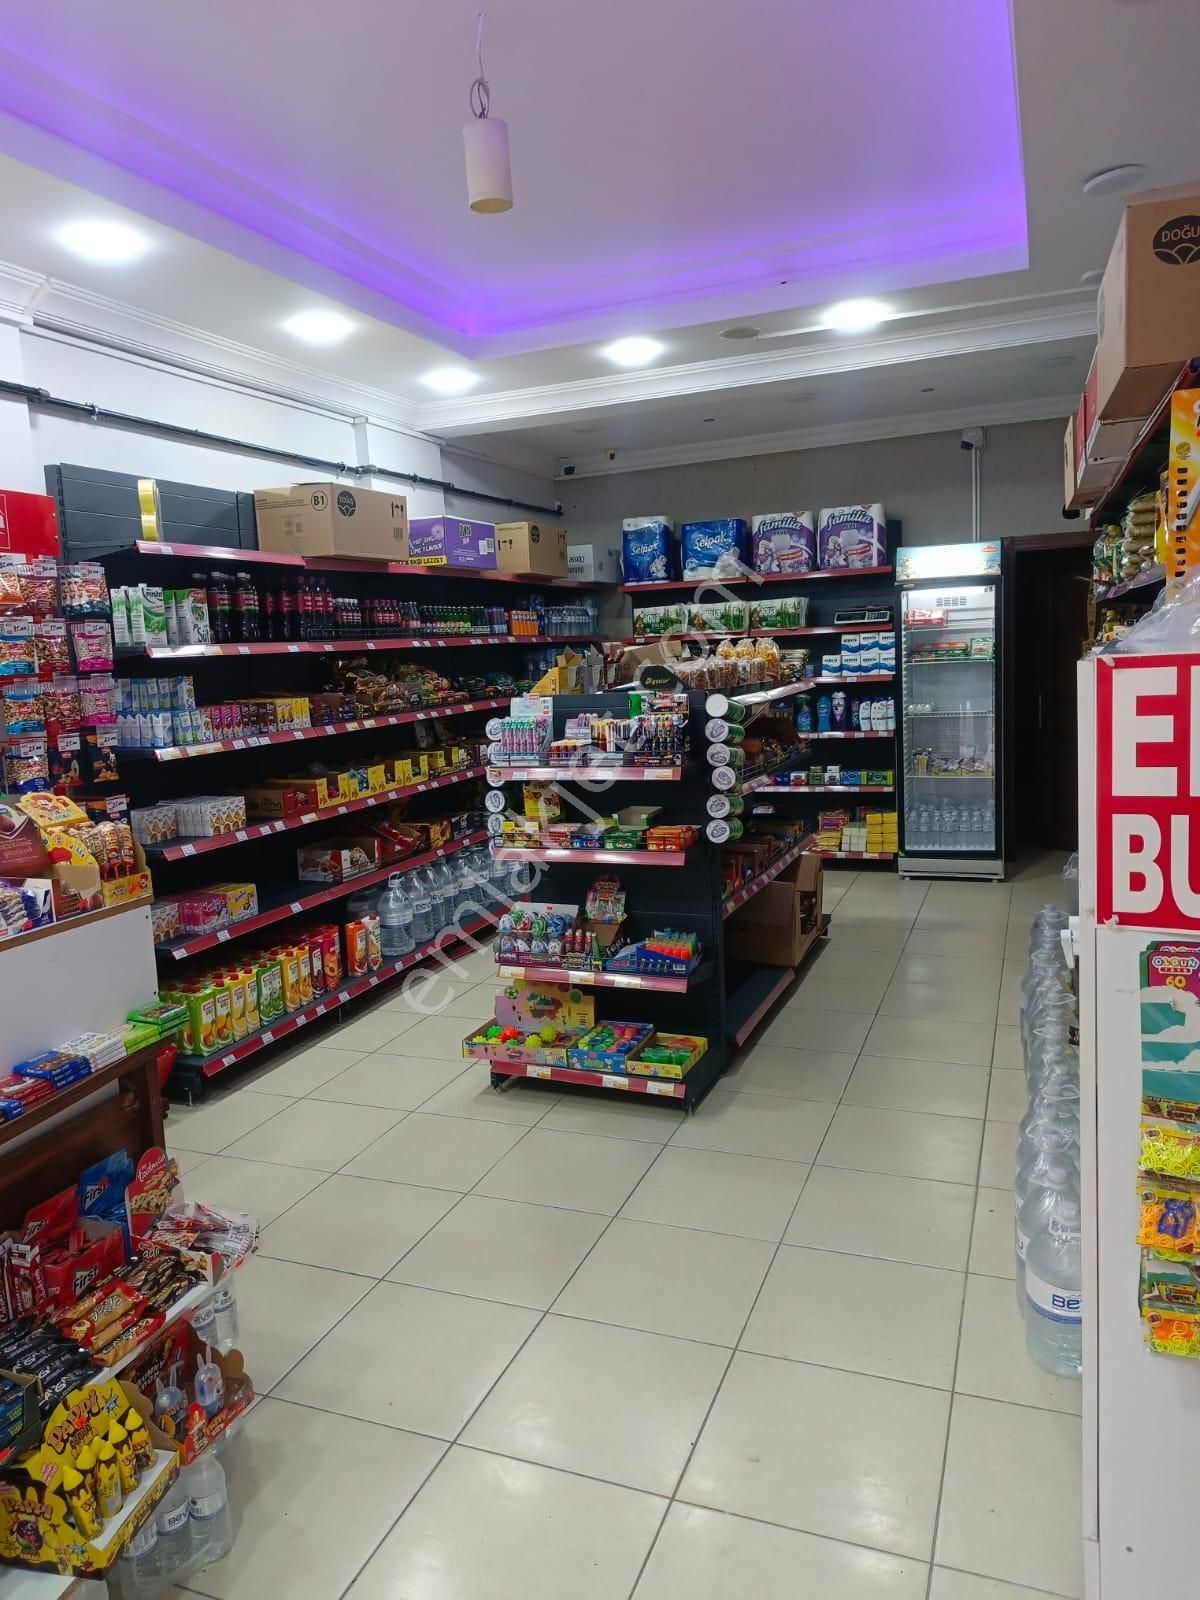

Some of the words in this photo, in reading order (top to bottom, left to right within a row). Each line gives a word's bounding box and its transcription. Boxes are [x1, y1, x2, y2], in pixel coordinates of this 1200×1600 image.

[313, 494, 325, 506] B1
[758, 516, 803, 538] familia
[827, 509, 873, 531] familia
[630, 542, 659, 557] Selpak
[694, 531, 727, 551] Selpak
[1112, 665, 1200, 797] E
[1154, 957, 1198, 969] OLGUN
[1166, 975, 1186, 988] 60
[85, 1184, 108, 1202] First
[73, 1264, 100, 1290] First
